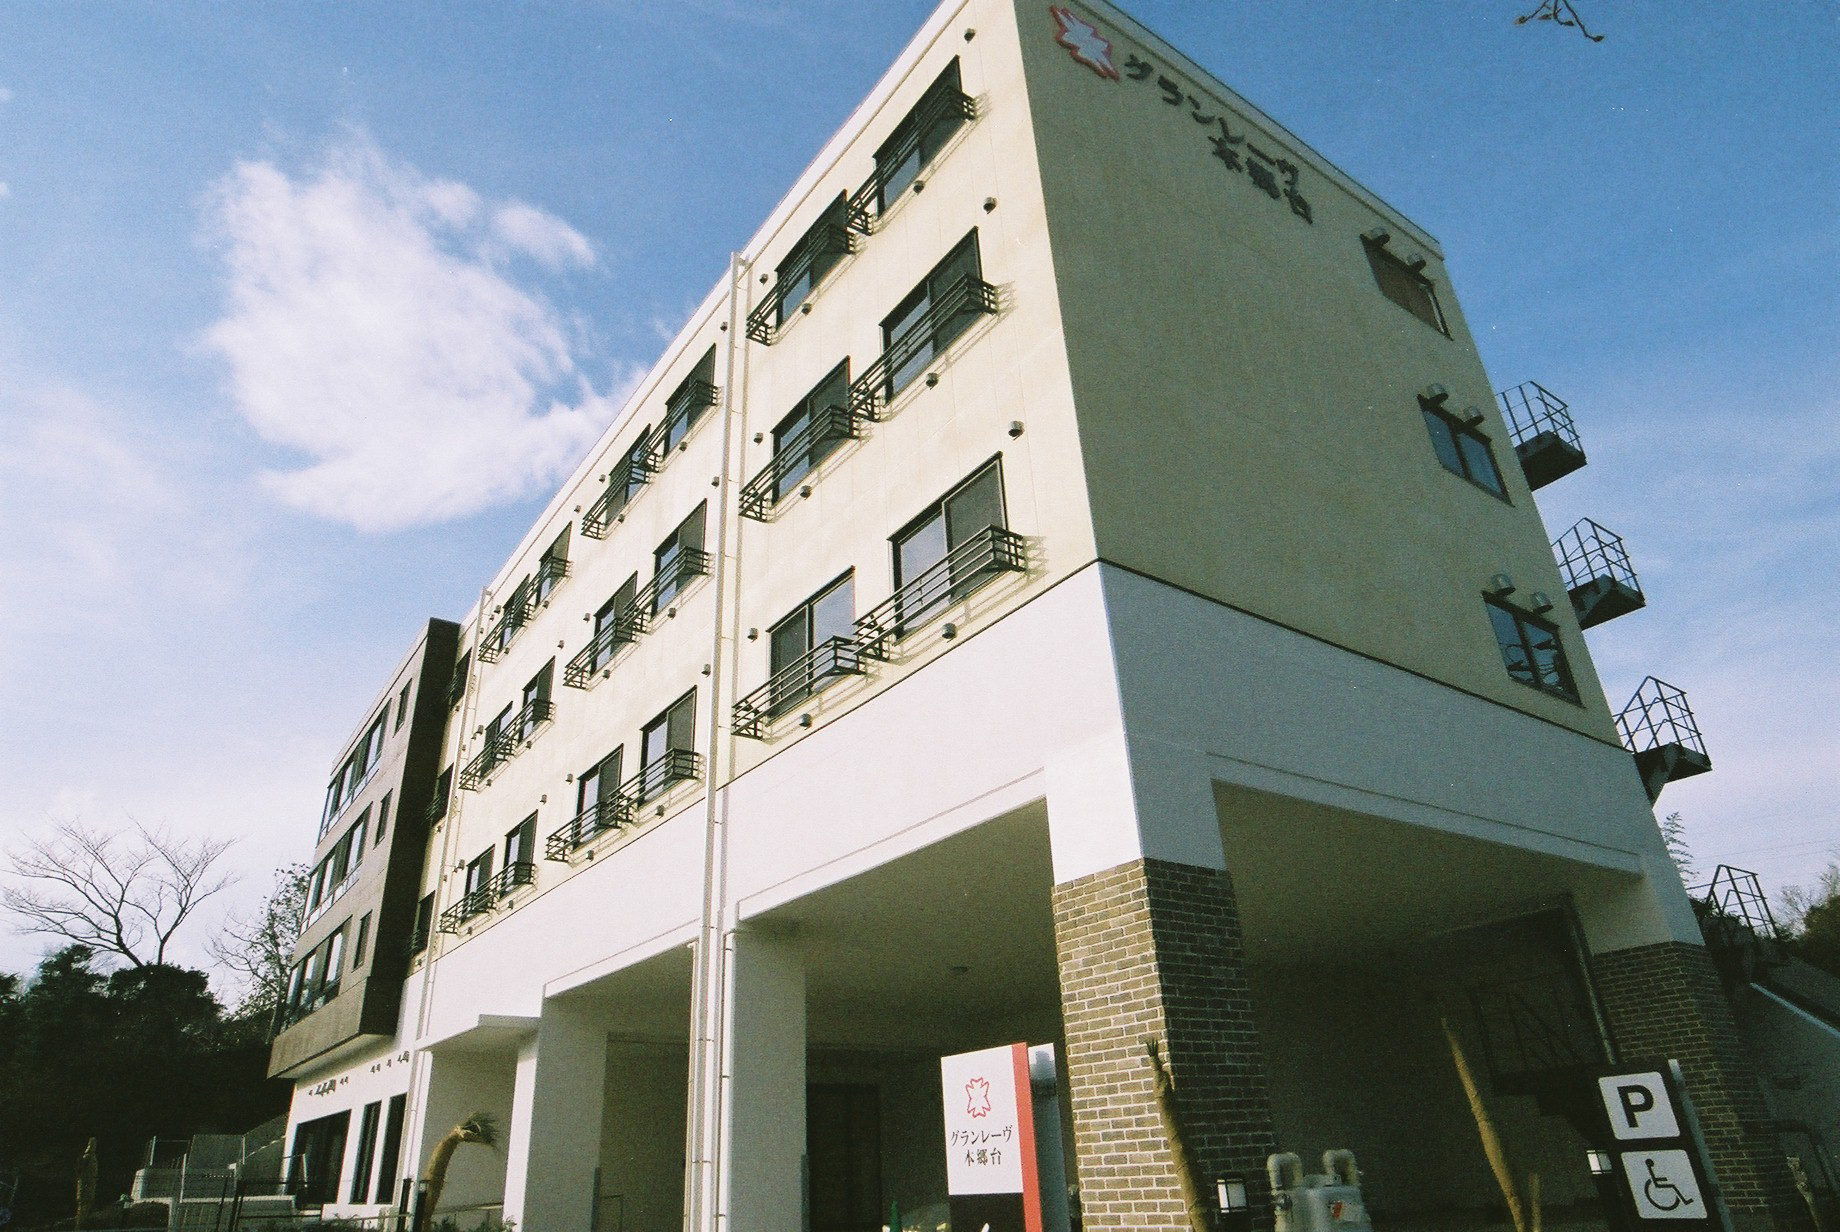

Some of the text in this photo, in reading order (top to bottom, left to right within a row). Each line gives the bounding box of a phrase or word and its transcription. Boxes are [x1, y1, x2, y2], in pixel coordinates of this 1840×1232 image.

[1616, 1084, 1654, 1128] P
[950, 1124, 1013, 1147] グランレーヴ
[964, 1147, 1002, 1166] 本郷台
